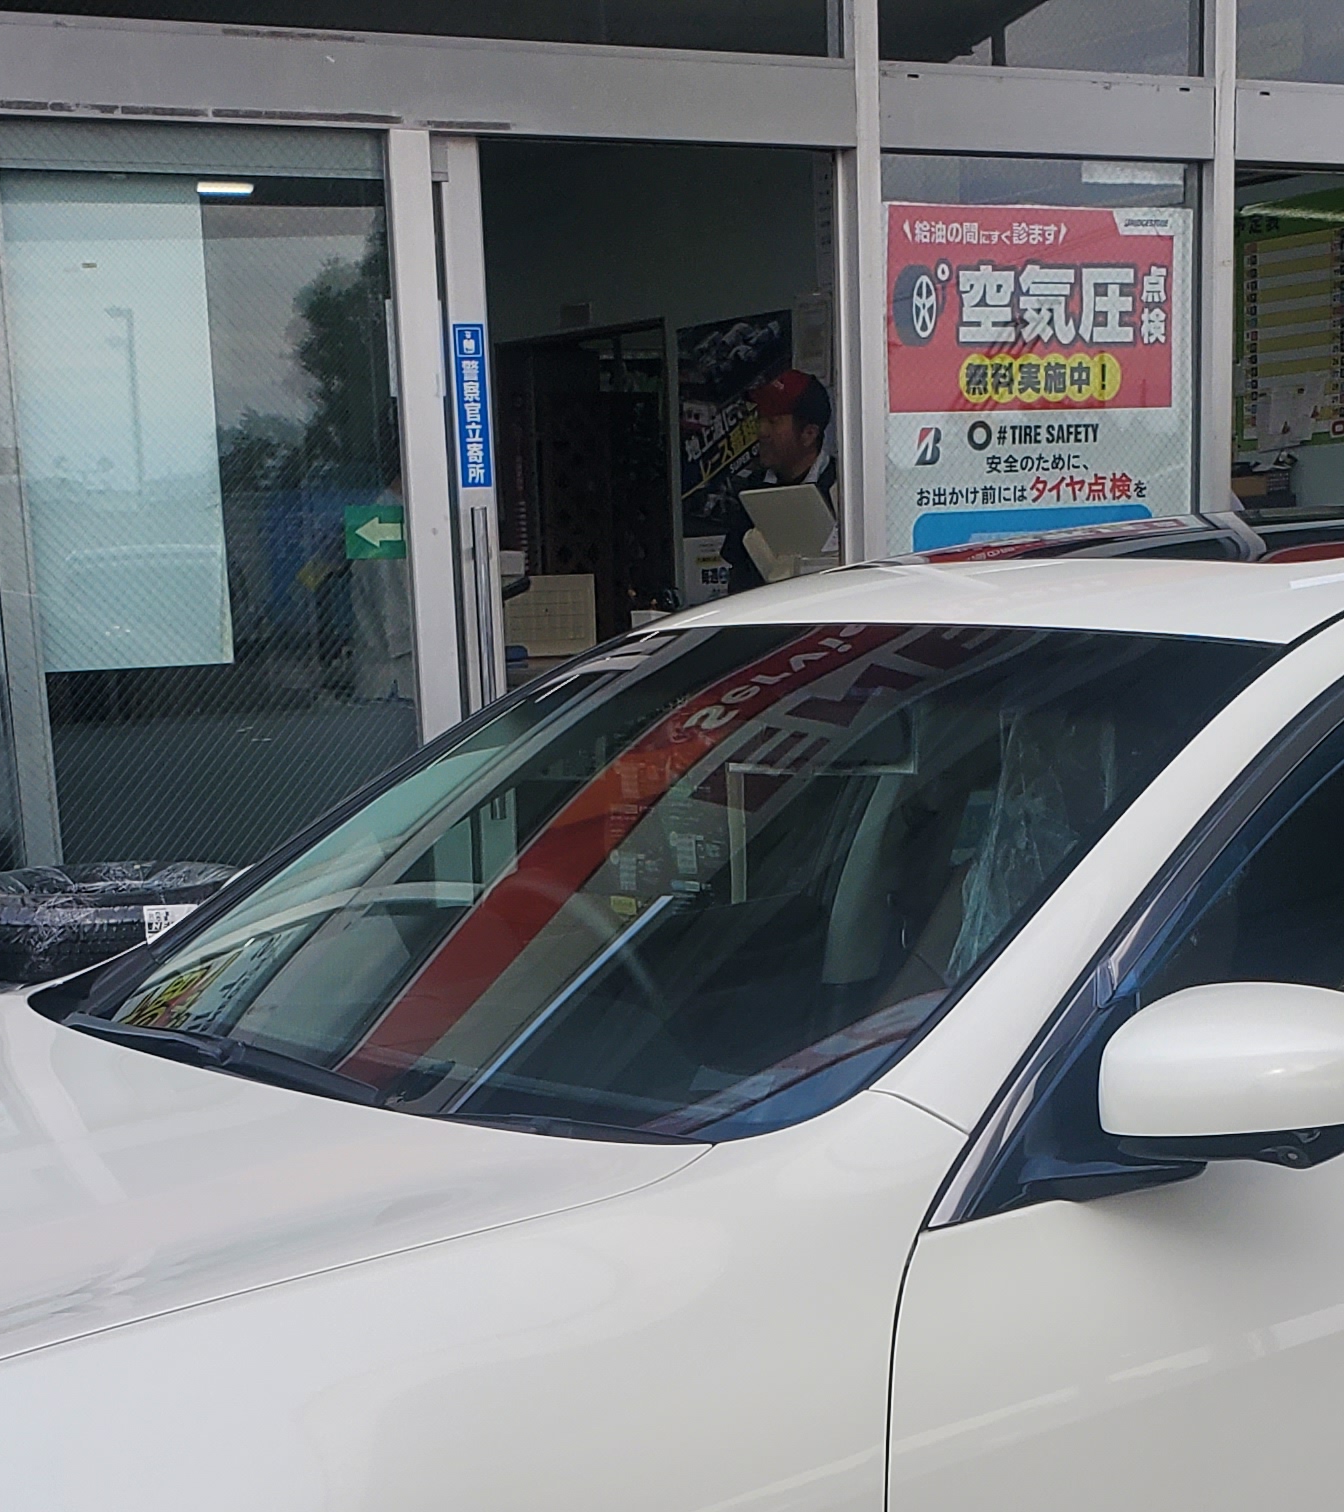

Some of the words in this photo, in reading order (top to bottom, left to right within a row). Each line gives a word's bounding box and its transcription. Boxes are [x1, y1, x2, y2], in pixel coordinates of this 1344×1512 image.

[958, 264, 1136, 345] 空気圧
[1140, 266, 1167, 345] 点検
[460, 359, 487, 485] 警察官立寄所
[1045, 422, 1100, 445] SAFETY
